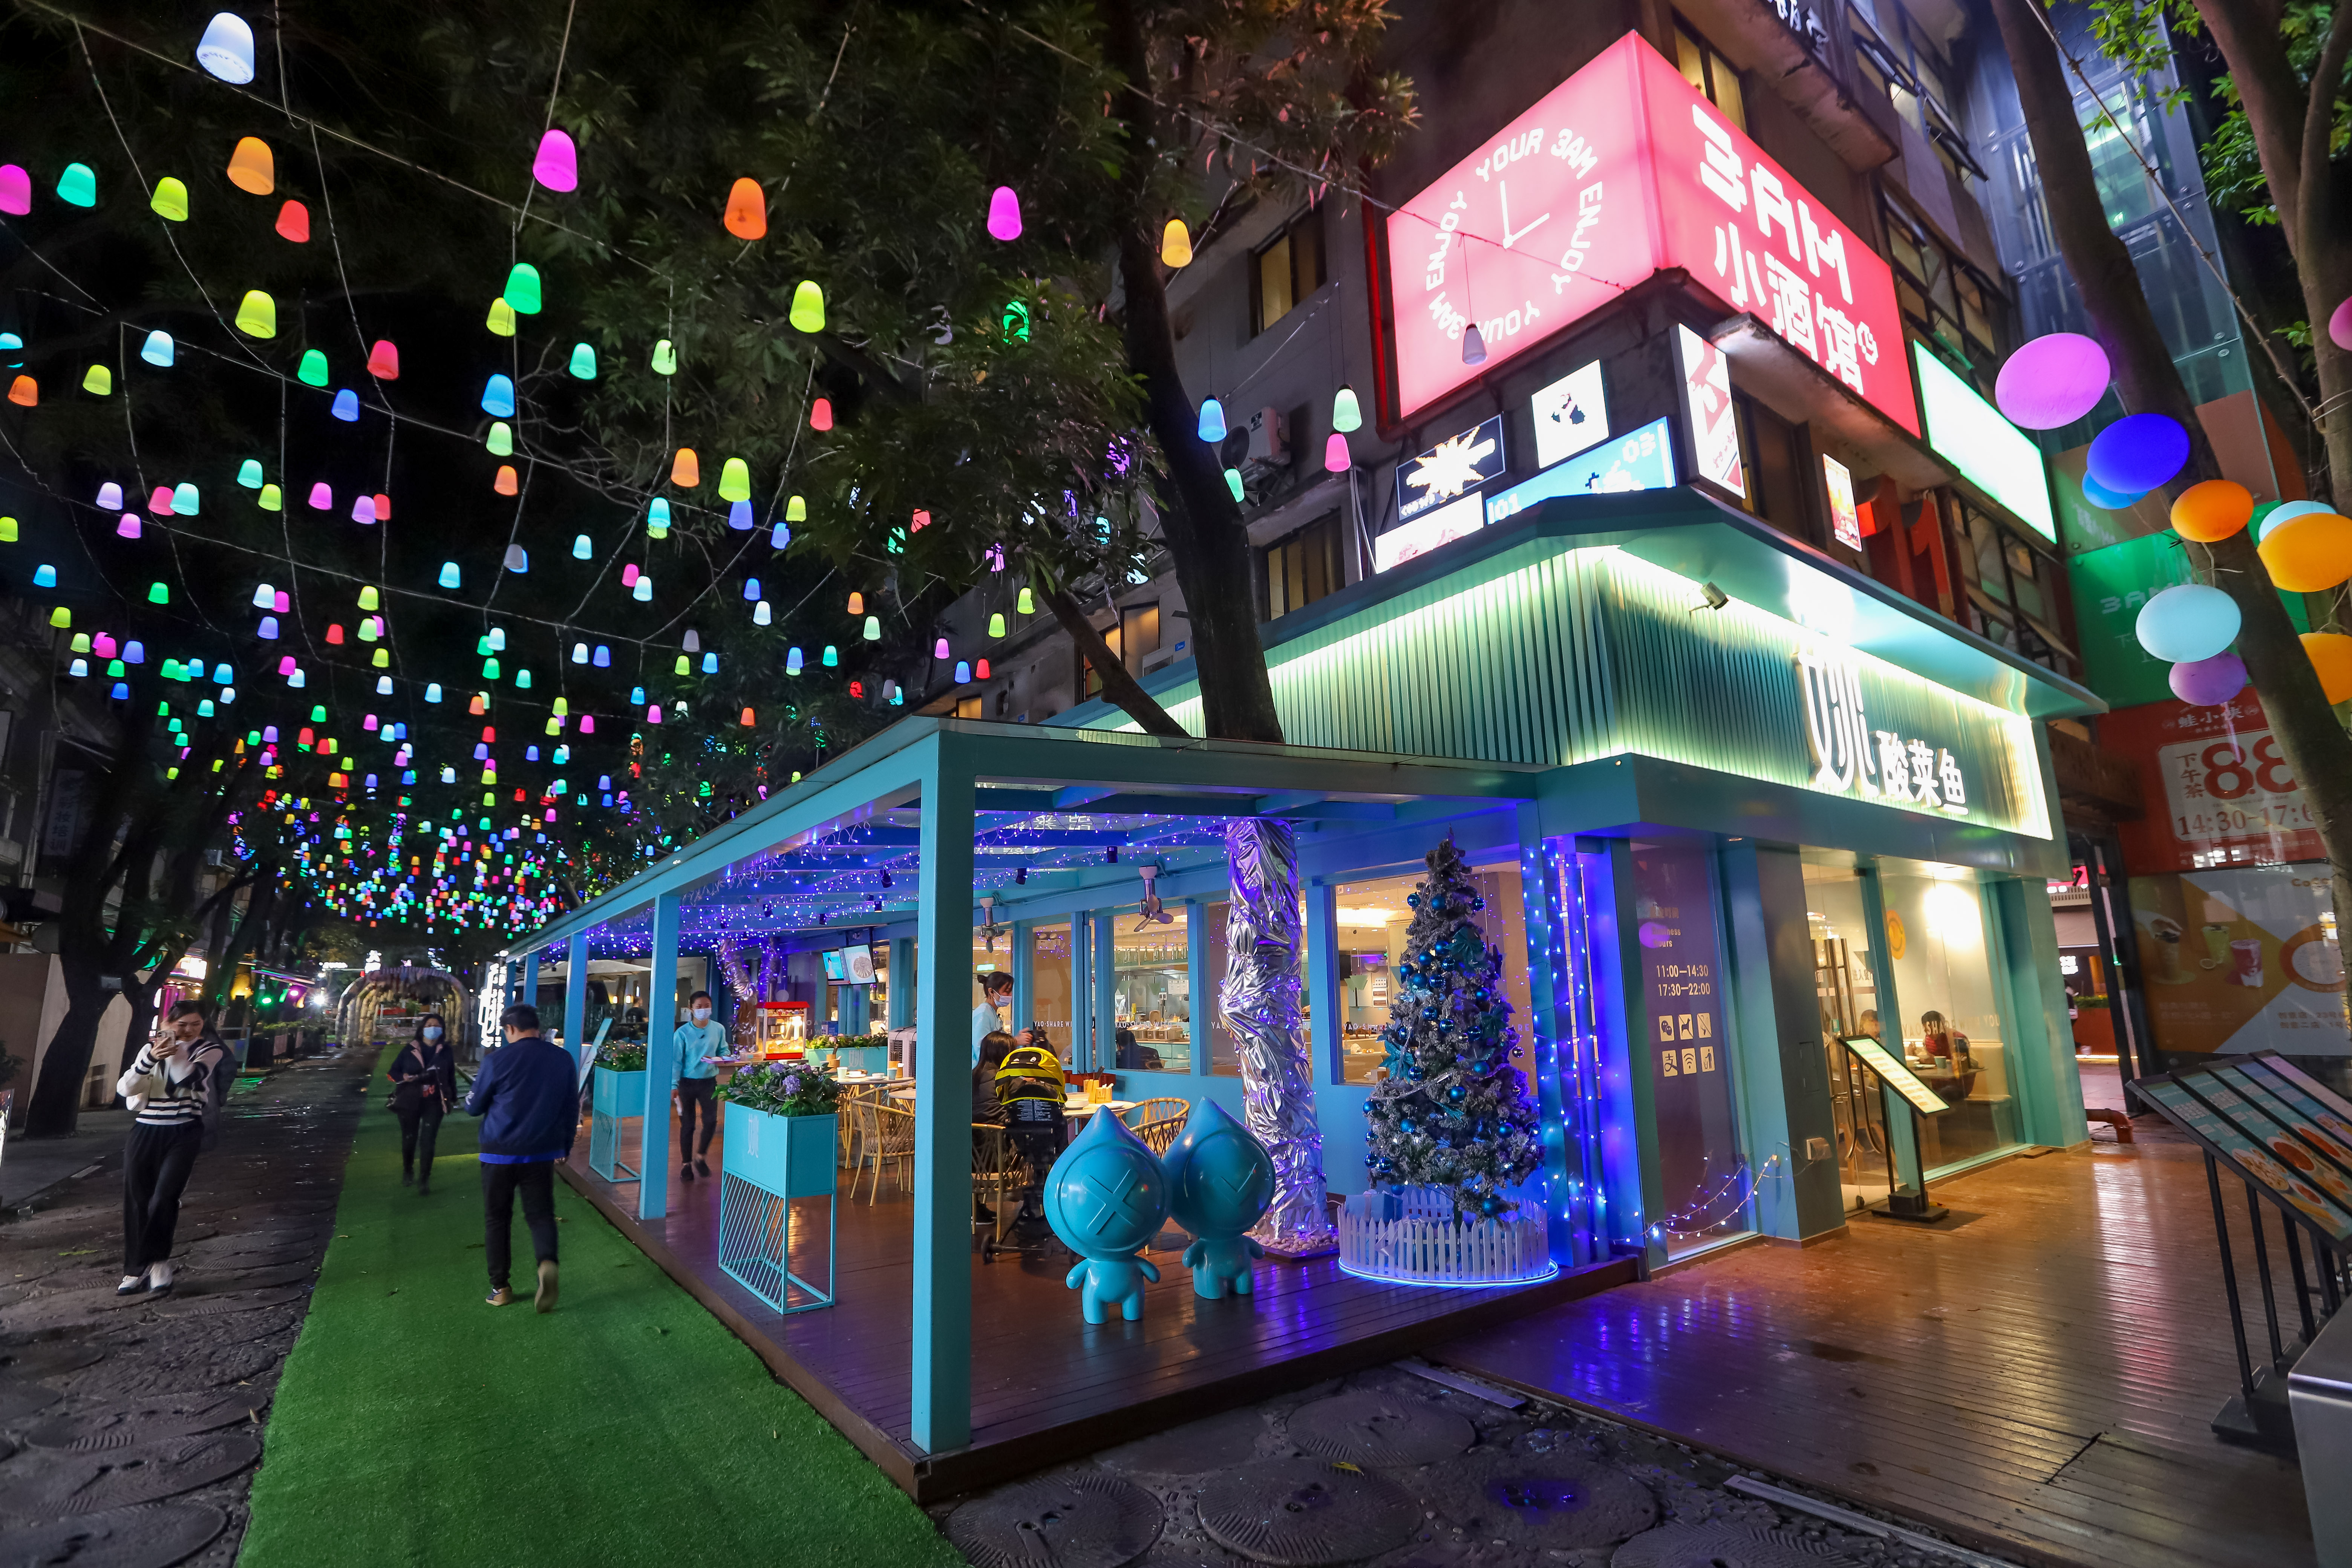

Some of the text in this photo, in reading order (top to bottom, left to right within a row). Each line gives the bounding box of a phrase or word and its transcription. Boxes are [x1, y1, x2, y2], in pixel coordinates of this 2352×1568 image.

[1475, 127, 1544, 182] YOUR
[1550, 128, 1598, 180] 3AM
[1426, 190, 1467, 291] ENJOY
[1550, 181, 1603, 295] ENJOY
[1692, 104, 1853, 305] 3AM
[1429, 291, 1466, 340] 3AM
[1714, 222, 1864, 396] 小酒馆
[1875, 729, 1969, 815] 酸菜鱼
[2175, 752, 2205, 799] 下午茶
